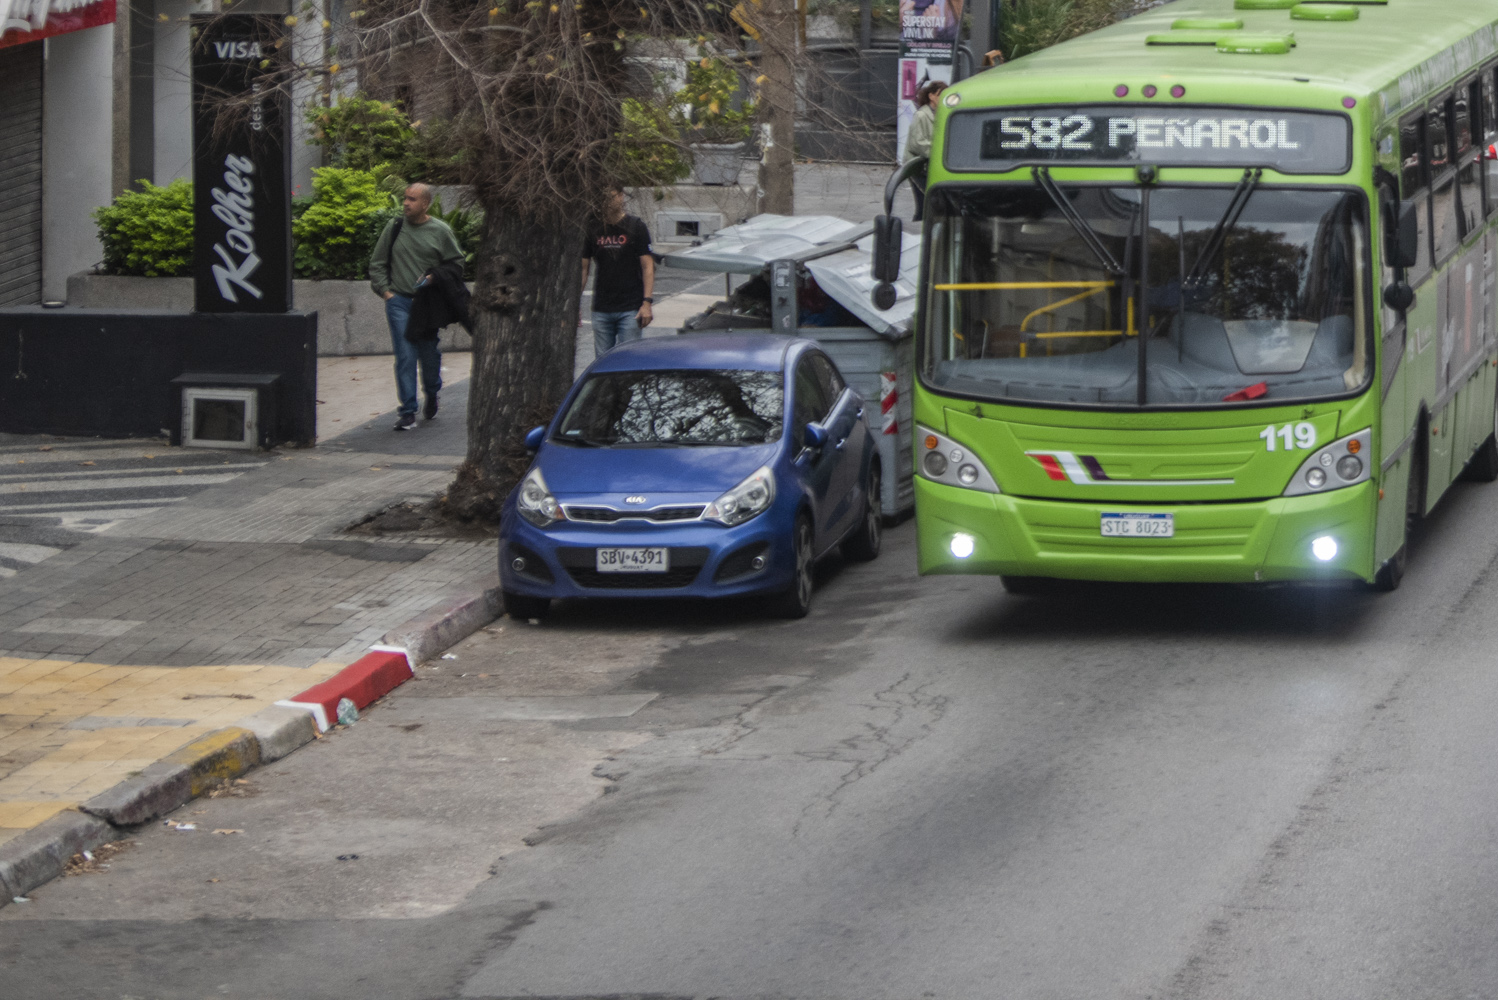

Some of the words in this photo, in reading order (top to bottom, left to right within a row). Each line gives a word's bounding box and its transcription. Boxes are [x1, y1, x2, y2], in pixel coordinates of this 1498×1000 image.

[903, 27, 922, 39] VINYL
[213, 41, 262, 59] VISA
[1000, 114, 1093, 149] 582
[1107, 117, 1299, 149] PEÑAROL
[211, 153, 264, 304] Kolher
[597, 235, 627, 245] HALO
[1259, 422, 1316, 452] 119
[1105, 520, 1129, 533] STC
[1135, 521, 1169, 534] 8023
